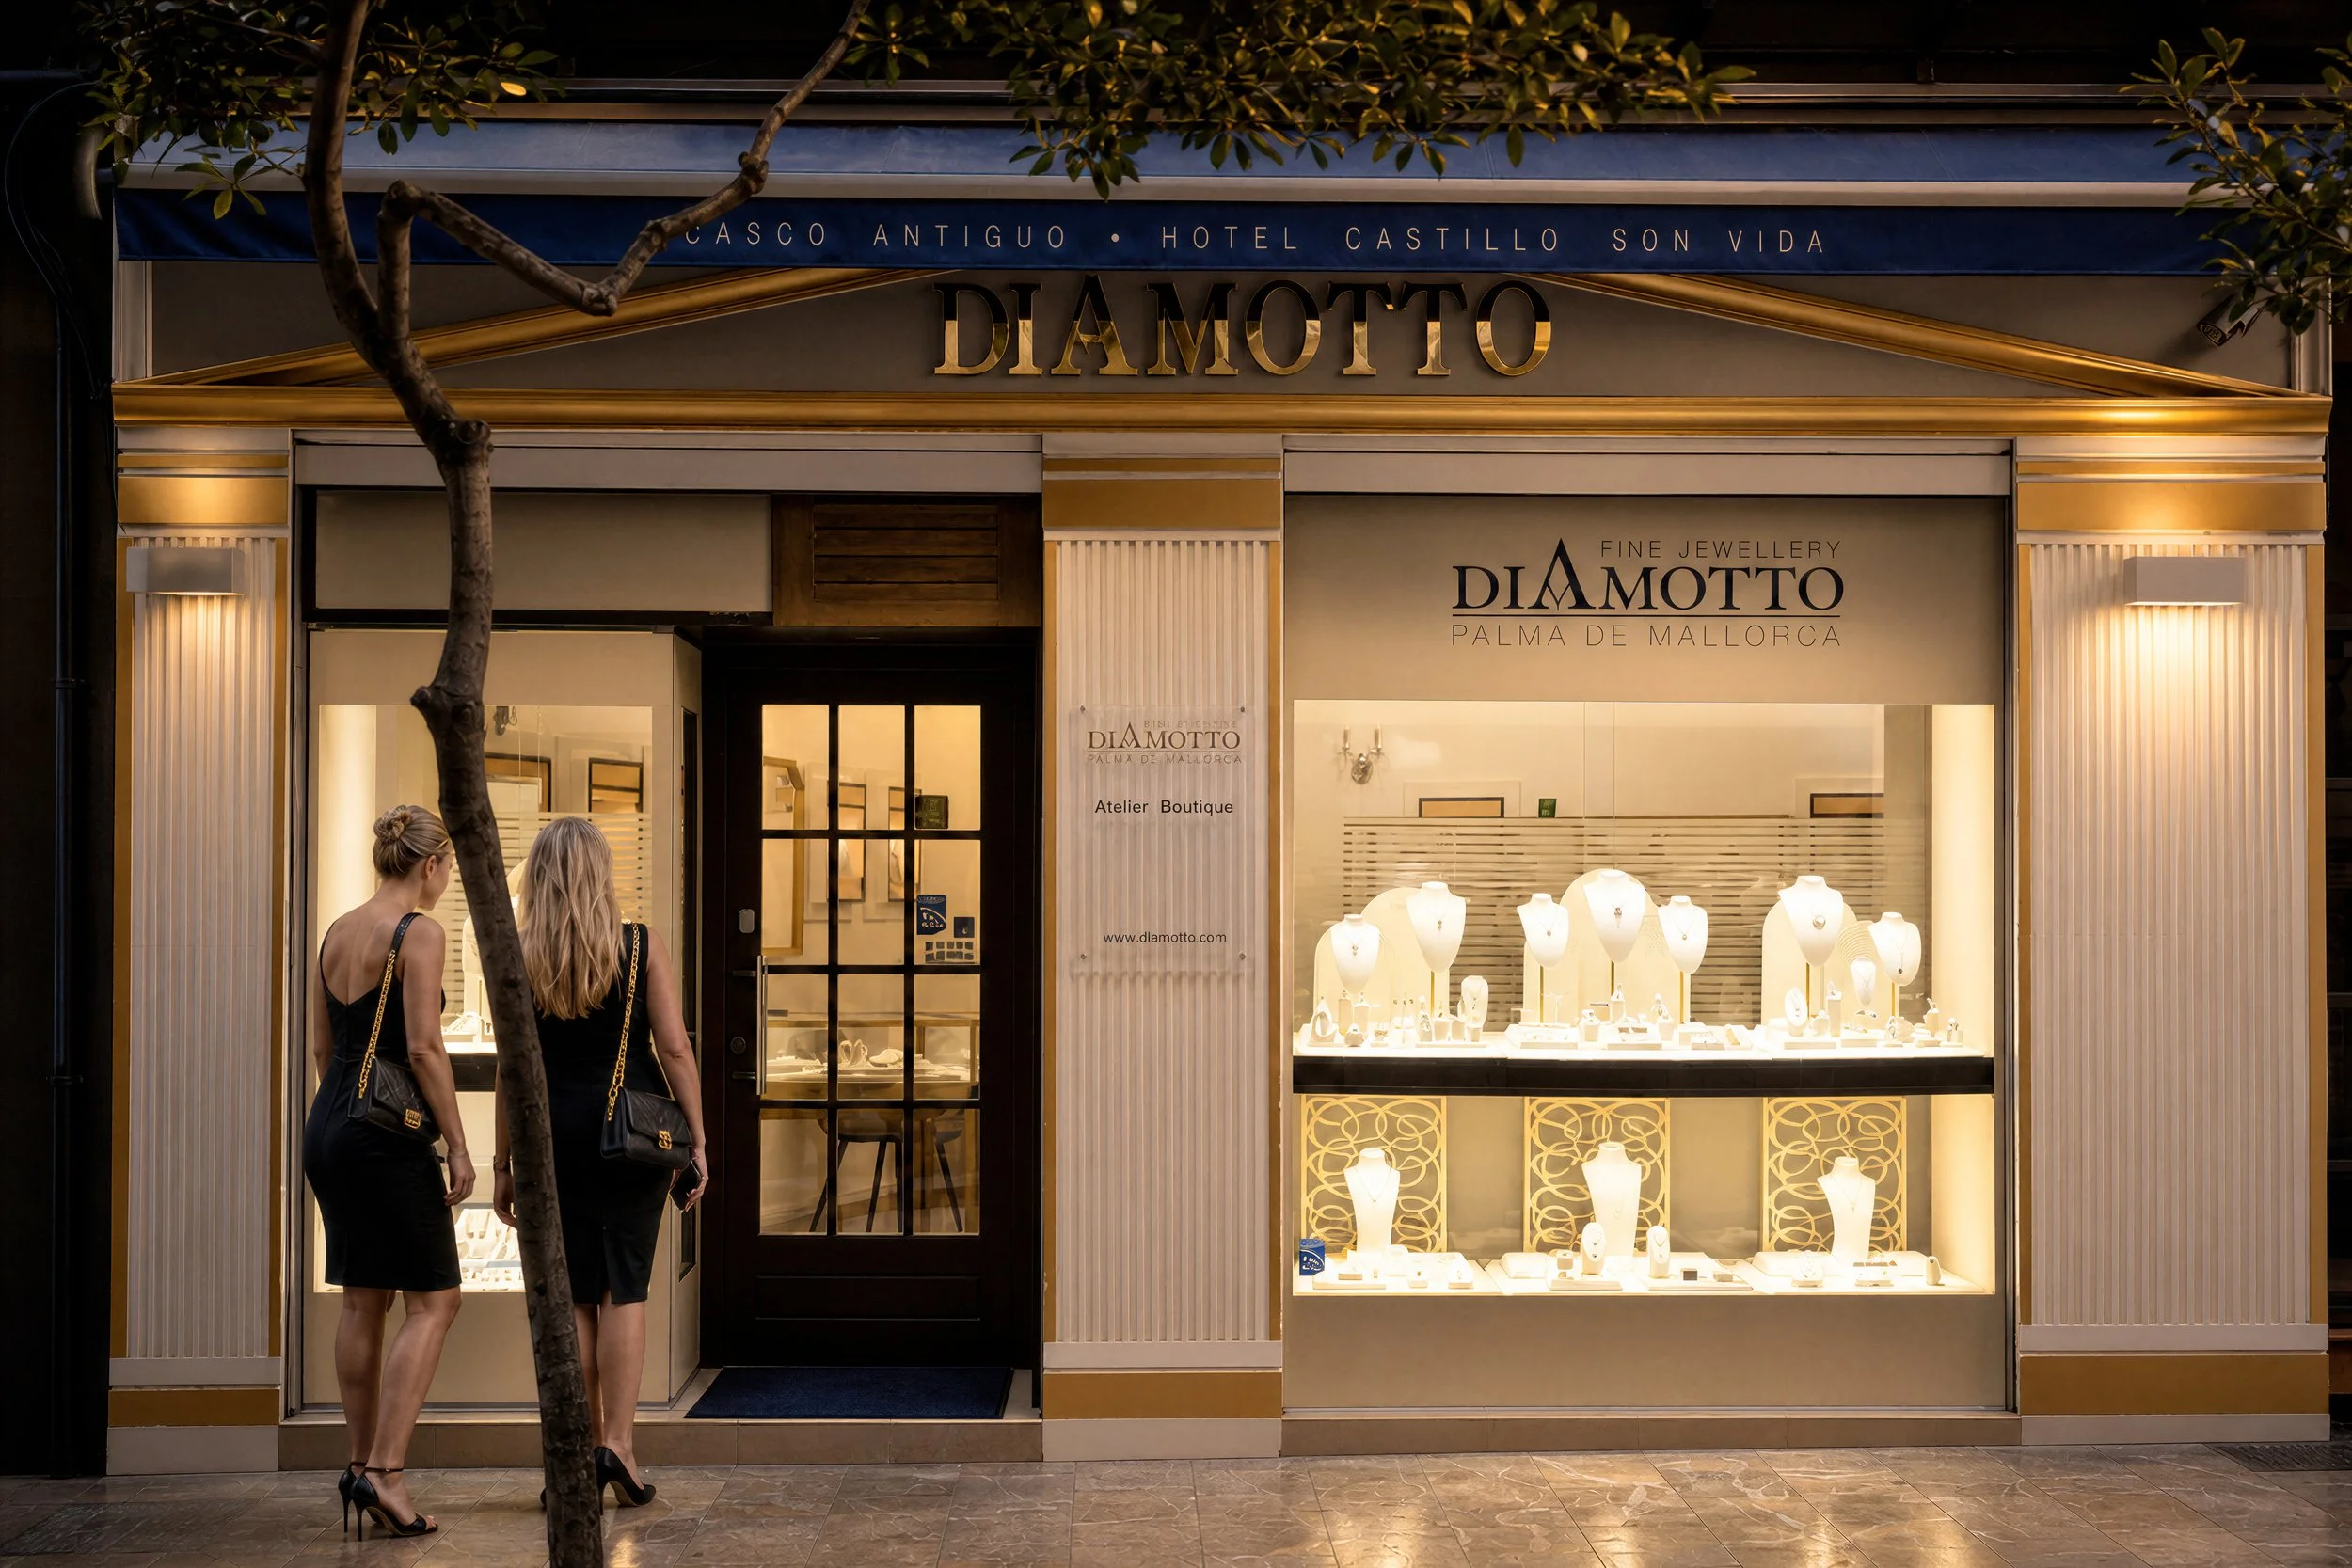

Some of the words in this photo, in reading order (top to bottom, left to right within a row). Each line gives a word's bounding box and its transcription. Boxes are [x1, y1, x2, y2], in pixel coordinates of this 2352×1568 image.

[686, 221, 825, 246] CASCO
[873, 223, 1064, 249] ANTIGUO
[1162, 225, 1297, 250] HOTEL
[1345, 226, 1557, 252] CASTILLO
[1613, 228, 1689, 252] SON
[1727, 230, 1823, 254] VIDA
[932, 274, 1551, 377] DIAMOTTO
[1600, 540, 1661, 559] FINE
[1678, 540, 1841, 559] JEWELLERY
[1452, 538, 1844, 611] DIAMOTTO
[1452, 625, 1565, 647] PALMA
[1586, 625, 1627, 647] DE
[1649, 625, 1841, 647] MALLORCA
[1088, 721, 1241, 750] DIAMOTTO
[1088, 755, 1132, 764] PALMA
[1140, 755, 1158, 764] DE
[1166, 755, 1242, 764] MALLORCA
[1095, 800, 1149, 814] Atelier
[1161, 800, 1233, 817] Boutique
